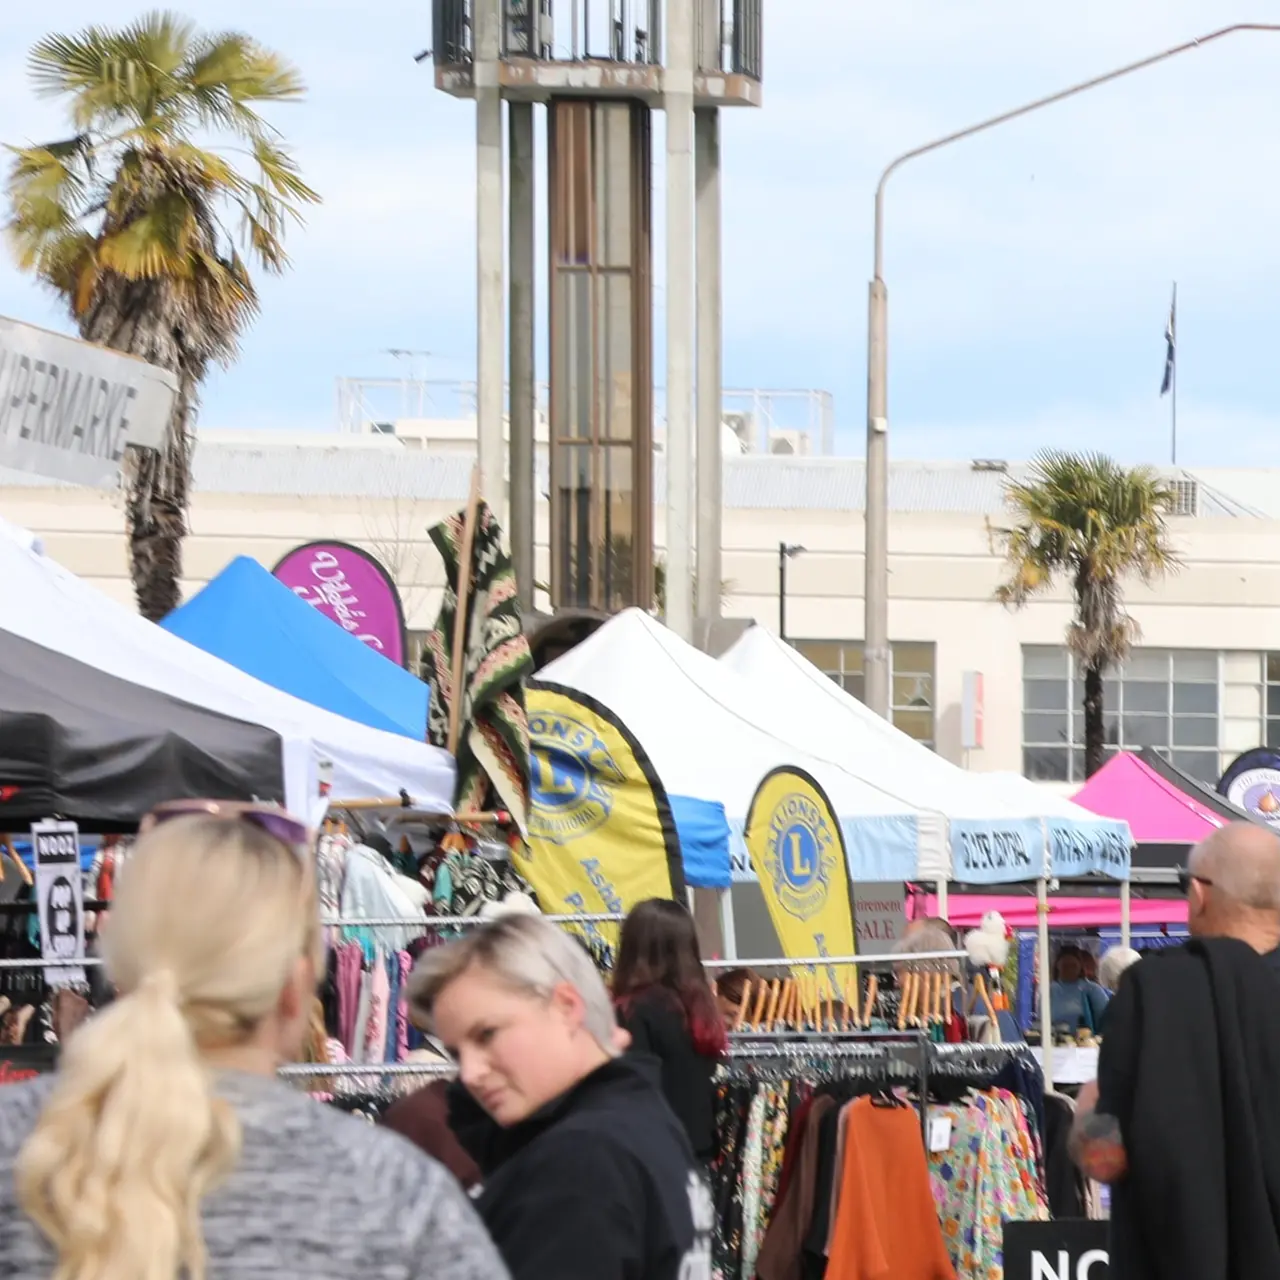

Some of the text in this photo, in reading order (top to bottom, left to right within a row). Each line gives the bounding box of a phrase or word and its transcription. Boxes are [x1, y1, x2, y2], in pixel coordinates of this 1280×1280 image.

[528, 718, 586, 747] ONS
[534, 750, 577, 793] L
[788, 832, 811, 877] L
